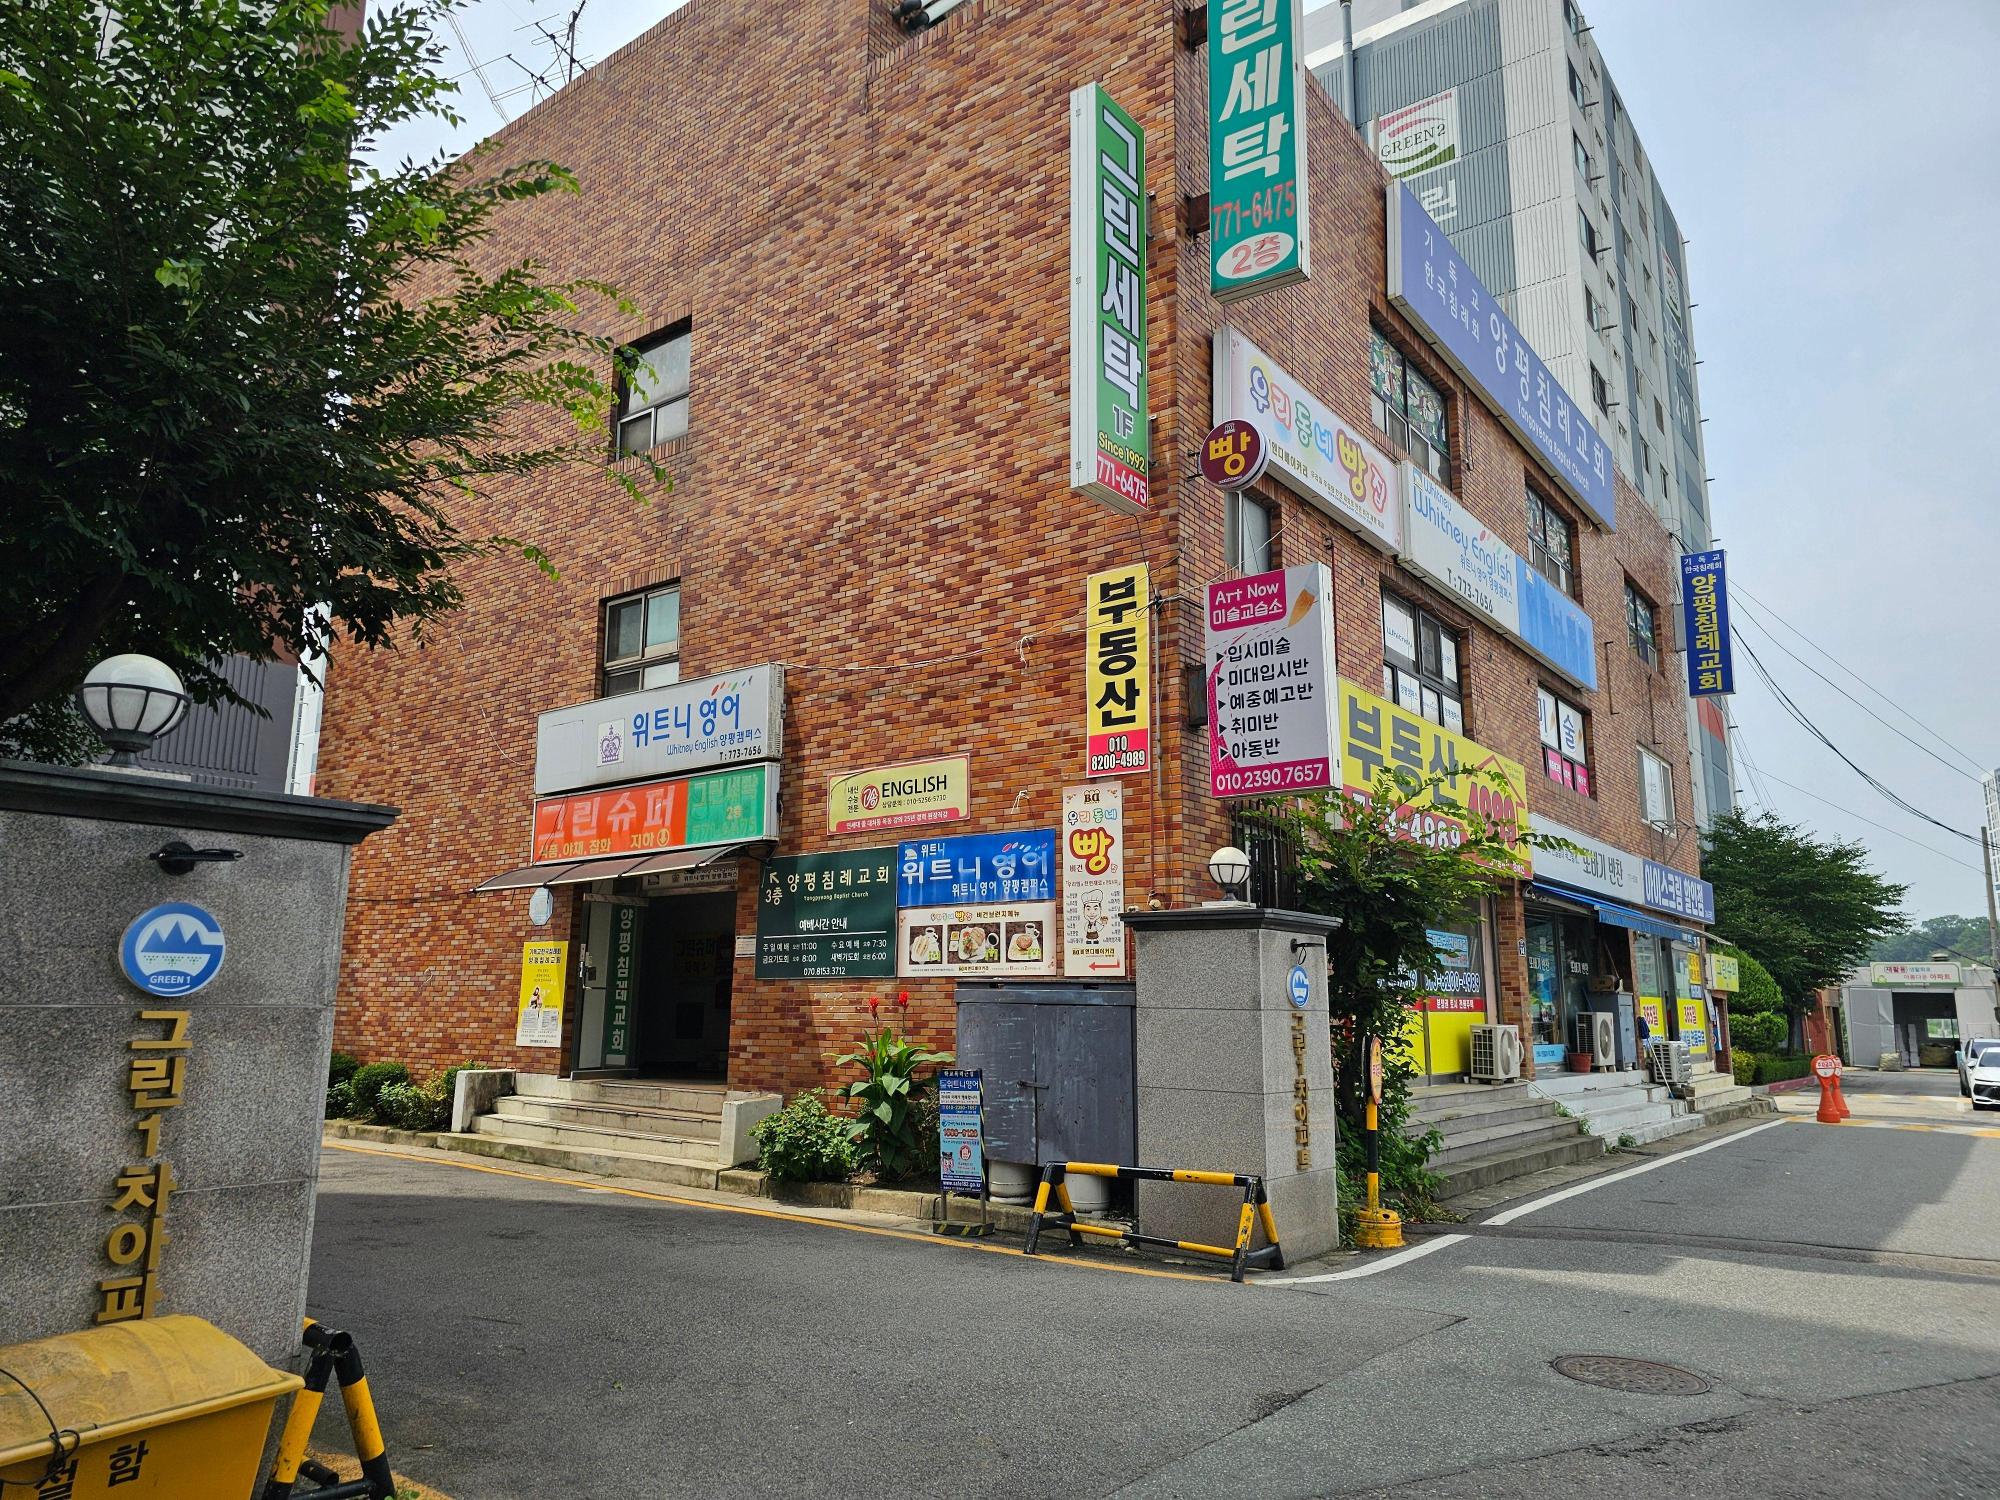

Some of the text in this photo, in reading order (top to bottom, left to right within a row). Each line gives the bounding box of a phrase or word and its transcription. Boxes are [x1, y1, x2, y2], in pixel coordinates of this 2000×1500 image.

[1381, 123, 1446, 157] GREEN 2
[1212, 180, 1296, 242] 771-6475
[1101, 105, 1143, 413] 그린세탁
[1231, 234, 1281, 276] 2층
[1424, 262, 1480, 343] 한국침례회
[1489, 312, 1605, 486] 양평침례교회
[1112, 403, 1135, 440] 1F
[1098, 431, 1146, 473] Since 1992
[1209, 431, 1251, 476] 빵
[1096, 454, 1148, 507] 771-6475
[1571, 466, 1590, 492] Church
[1413, 487, 1468, 552] Whitney
[1471, 536, 1512, 586] English
[1215, 582, 1279, 605] Art Now
[1212, 598, 1283, 625] 미술교습소
[1691, 573, 1723, 690] 양평침례교회
[1095, 576, 1141, 728] 부동산
[1227, 636, 1291, 663] 입시미술
[1228, 657, 1309, 687] 미대입시반
[1229, 683, 1314, 711] 예중예고반
[632, 693, 740, 748] 위트니 영어
[1230, 712, 1280, 735] 취미반
[667, 728, 762, 756] Whitney English 양평캠퍼스
[1108, 735, 1129, 753] 010
[1231, 737, 1281, 759] 아동반
[1348, 695, 1459, 806] 부동산
[1091, 750, 1146, 772] 8200-4989
[693, 773, 759, 808] 그린세탁
[847, 785, 859, 794] 내신
[881, 774, 947, 798] ENGLISH
[1216, 763, 1324, 791] 010.2390.7657
[538, 784, 676, 841] 그린슈퍼
[847, 795, 859, 803] 수능
[847, 805, 859, 813] 전문
[904, 815, 916, 824] 25년
[1068, 808, 1118, 826] 우리동네
[589, 837, 612, 854] 잡화
[630, 832, 655, 848] 지하
[921, 842, 946, 858] 위트니
[1069, 827, 1115, 875] 빵
[787, 865, 889, 892] 양평침례교회
[902, 850, 1049, 885] 위트니 영어
[1069, 864, 1083, 872] 비건
[1608, 853, 1624, 888] 반찬
[766, 887, 783, 905] 3층
[952, 882, 977, 896] 위트니
[980, 881, 997, 896] 영어
[1002, 878, 1049, 893] 양평캠퍼스
[1644, 863, 1705, 918] 아이스크림 할인점
[799, 917, 848, 932] 예배시간 안내
[801, 942, 817, 951] 11:00
[830, 952, 860, 962] 새벽기도회
[871, 952, 887, 960] 6:00
[872, 939, 887, 948] 7:30
[763, 955, 789, 964] 금요기도회
[801, 954, 817, 962] 8:00
[803, 966, 846, 976] 070.8153.3712
[150, 975, 191, 984] GREEN 1
[611, 908, 634, 1051] 양평침례교회
